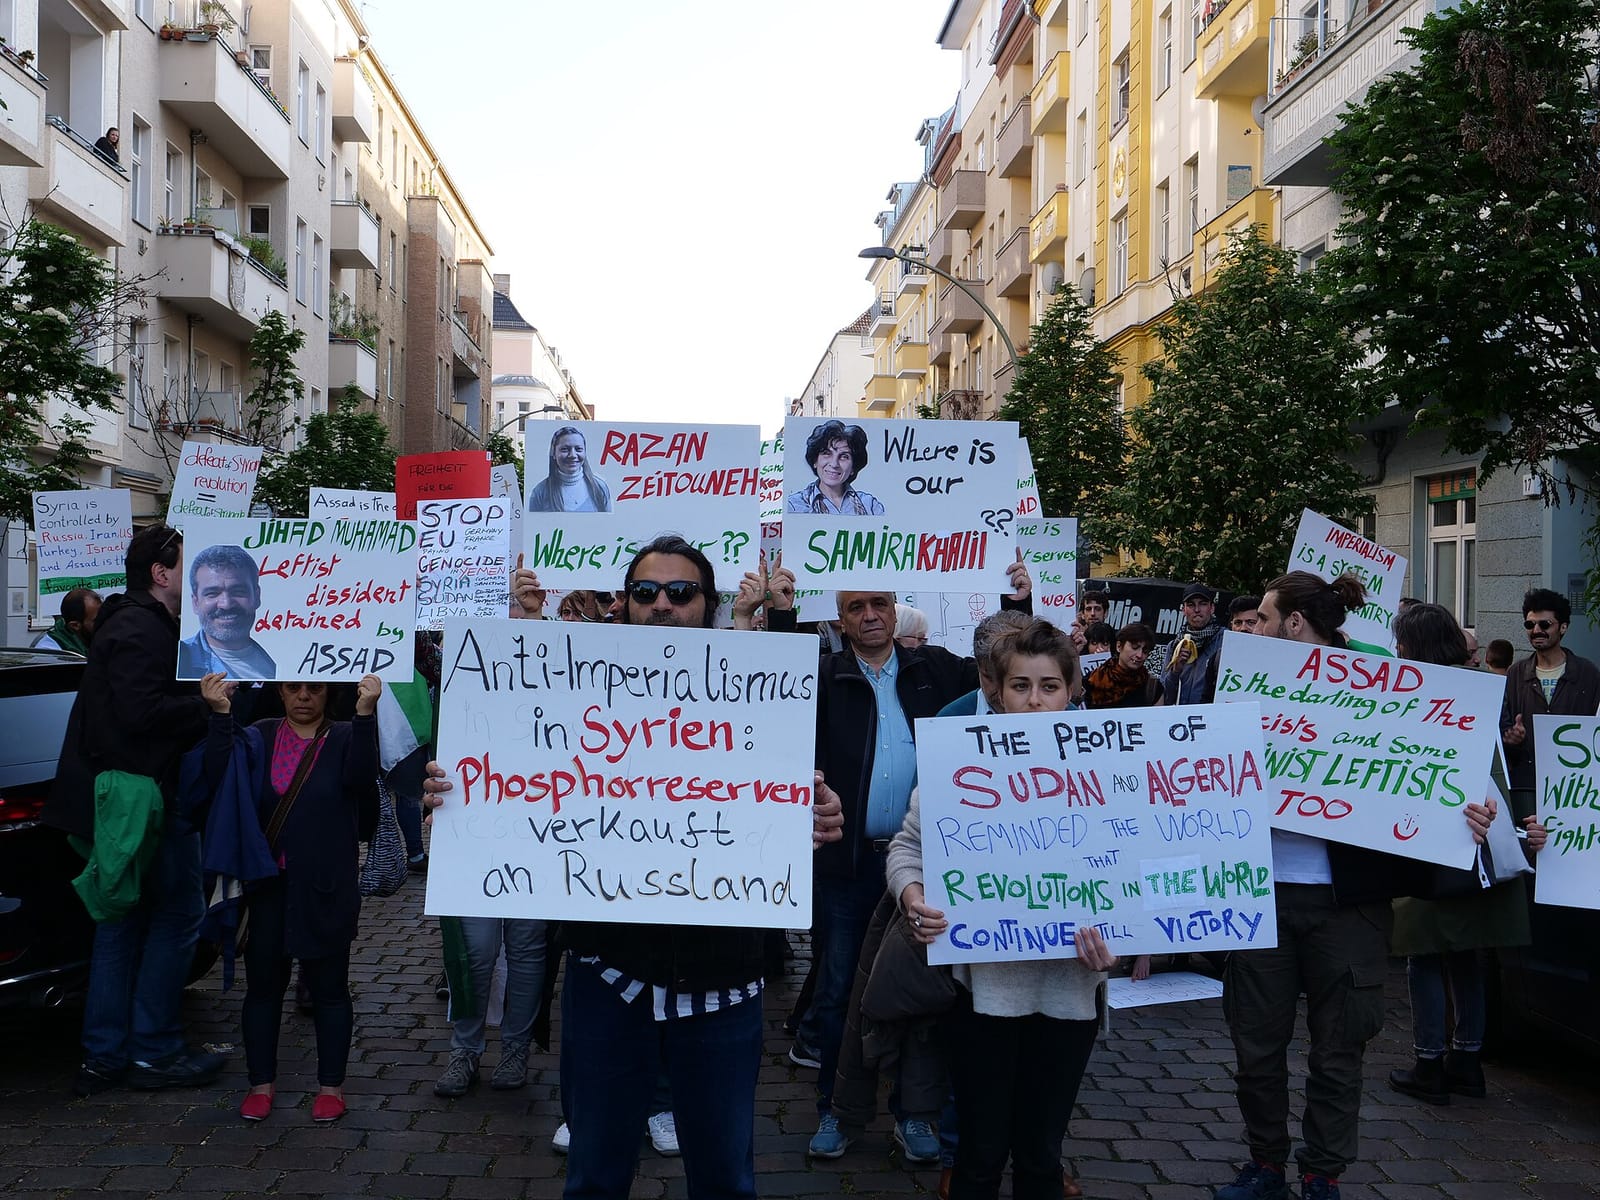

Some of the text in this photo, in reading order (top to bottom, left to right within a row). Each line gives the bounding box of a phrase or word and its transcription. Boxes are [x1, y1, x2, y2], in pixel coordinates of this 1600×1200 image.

[184, 445, 227, 469] defeat
[600, 429, 709, 468] RAZAN
[884, 425, 997, 466] Where is
[408, 463, 468, 479] FREIHEIT
[616, 466, 760, 502] ZEITOUNEH
[905, 475, 964, 495] our
[194, 475, 248, 497] revolution
[36, 495, 98, 517] Syria is
[313, 493, 389, 512] Assad is The
[420, 503, 504, 528] STOP
[39, 513, 119, 530] controlled by
[1043, 521, 1061, 537] is
[86, 542, 124, 555] Israel
[243, 519, 418, 555] JIHAD MUHAMAD
[418, 529, 455, 549] EU
[533, 528, 607, 573] Where
[721, 530, 750, 564] ??
[803, 524, 917, 575] SAMIRA
[1325, 526, 1396, 572] IMPERIALISM
[40, 562, 60, 572] and
[65, 557, 98, 569] Assad
[102, 558, 113, 566] is
[258, 552, 342, 579] Leftist
[418, 555, 506, 573] GENOCIDE
[1032, 550, 1076, 563] serves
[1316, 554, 1326, 572] A
[45, 579, 93, 594] favorite
[418, 575, 471, 595] SYRIA
[459, 567, 506, 579] YEMEN
[306, 578, 412, 607] dissident
[417, 592, 475, 606] SUDAN
[255, 607, 362, 632] detained
[417, 606, 468, 619] LIBYA
[1105, 598, 1142, 630] Mie
[376, 621, 405, 646] by
[297, 642, 396, 676] ASSAD
[443, 628, 814, 708] Anti-Imperialismus
[1296, 647, 1424, 693] ASSAD
[1218, 667, 1477, 732] is the darling of The
[533, 706, 569, 750] in
[965, 715, 1208, 760] THE PEOPLE OF
[1332, 730, 1383, 749] and
[1552, 723, 1600, 769] S
[455, 752, 811, 815] Phosphorreserven
[952, 750, 1264, 810] SUDAN AND ALGERIA
[1322, 752, 1467, 808] LEFTISTS
[1274, 789, 1353, 820] TOO
[528, 805, 735, 848] verkauft
[936, 808, 1253, 857] REMINDED THE WORLD
[1083, 849, 1120, 870] THAT
[482, 849, 799, 907] an Russland
[941, 859, 1271, 915] REVOLUTIONS IN THE WORLD
[949, 907, 1264, 954] CONTINUE TILL VICTORY
